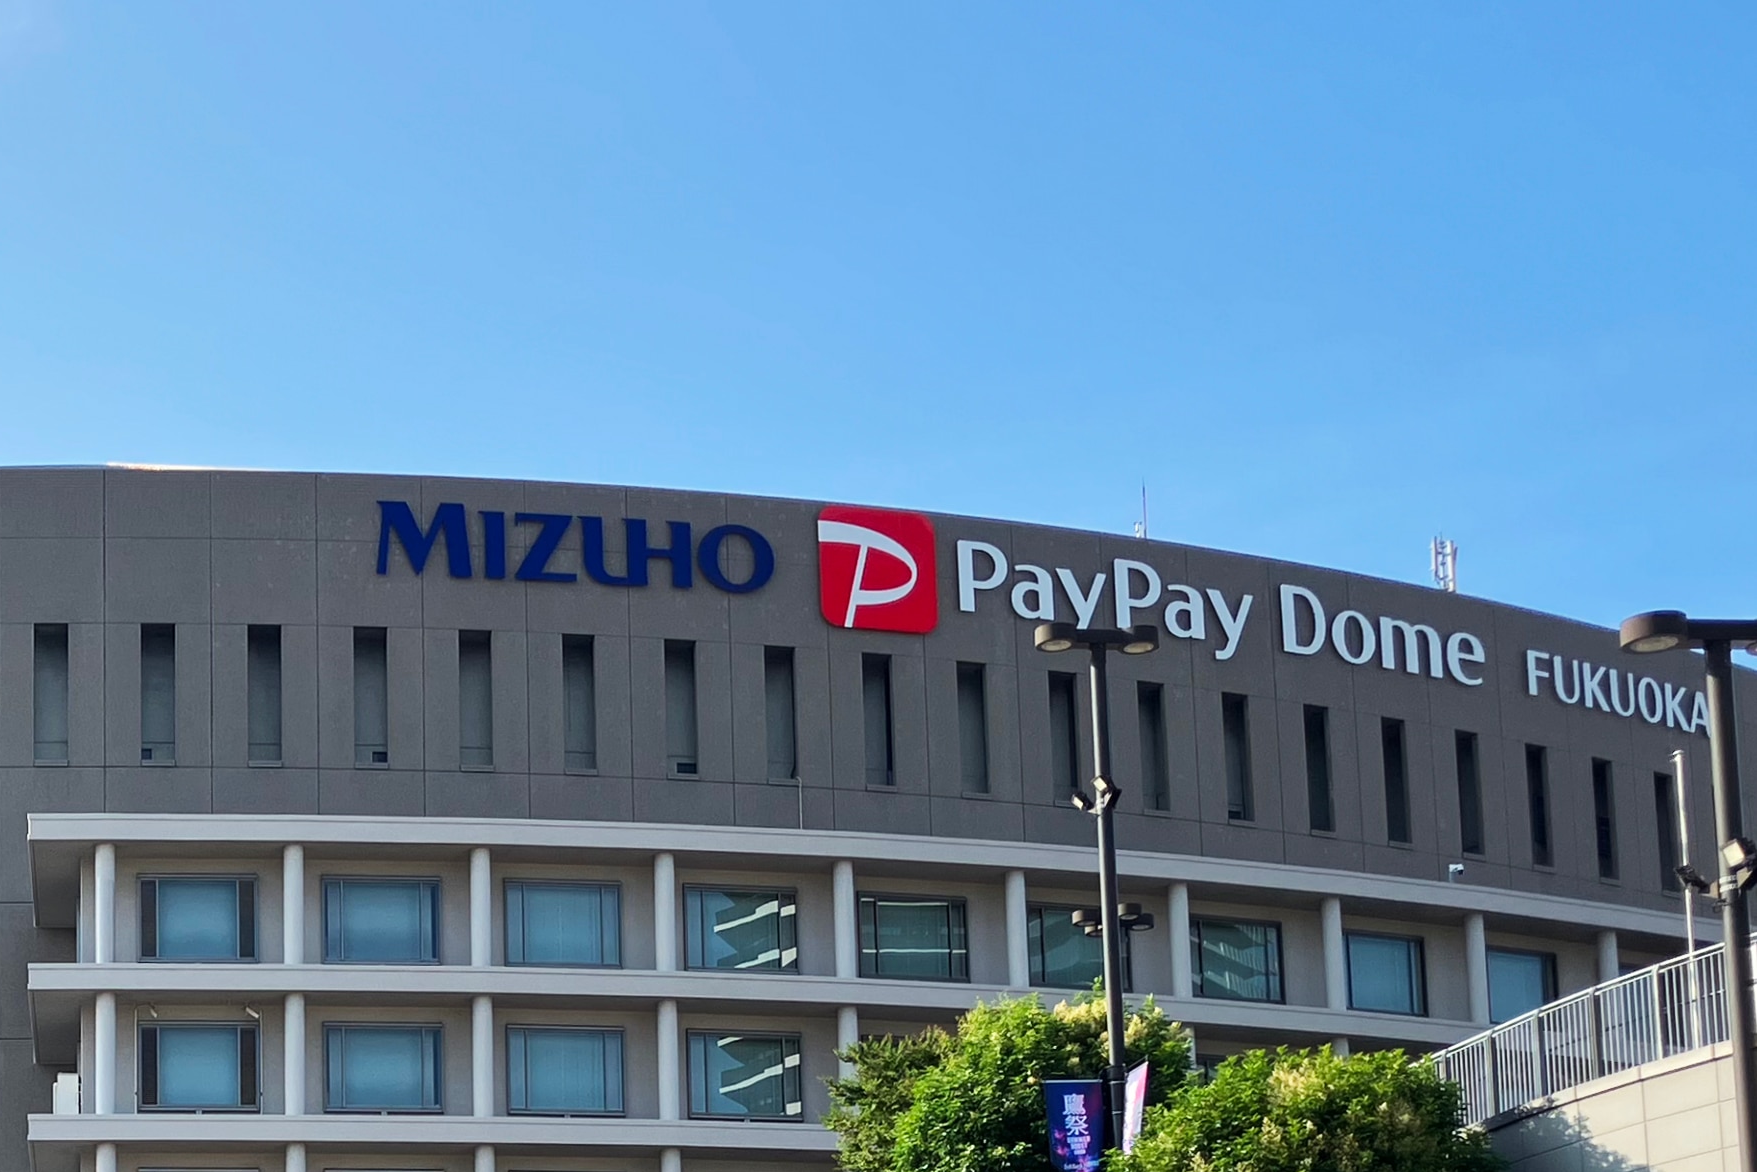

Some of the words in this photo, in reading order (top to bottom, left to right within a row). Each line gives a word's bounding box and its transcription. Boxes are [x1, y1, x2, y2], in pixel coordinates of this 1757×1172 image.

[376, 499, 775, 594] MIZUHO
[956, 539, 1254, 661] PayPay
[1279, 583, 1486, 687] Dome
[1525, 648, 1712, 738] FUKUOKA
